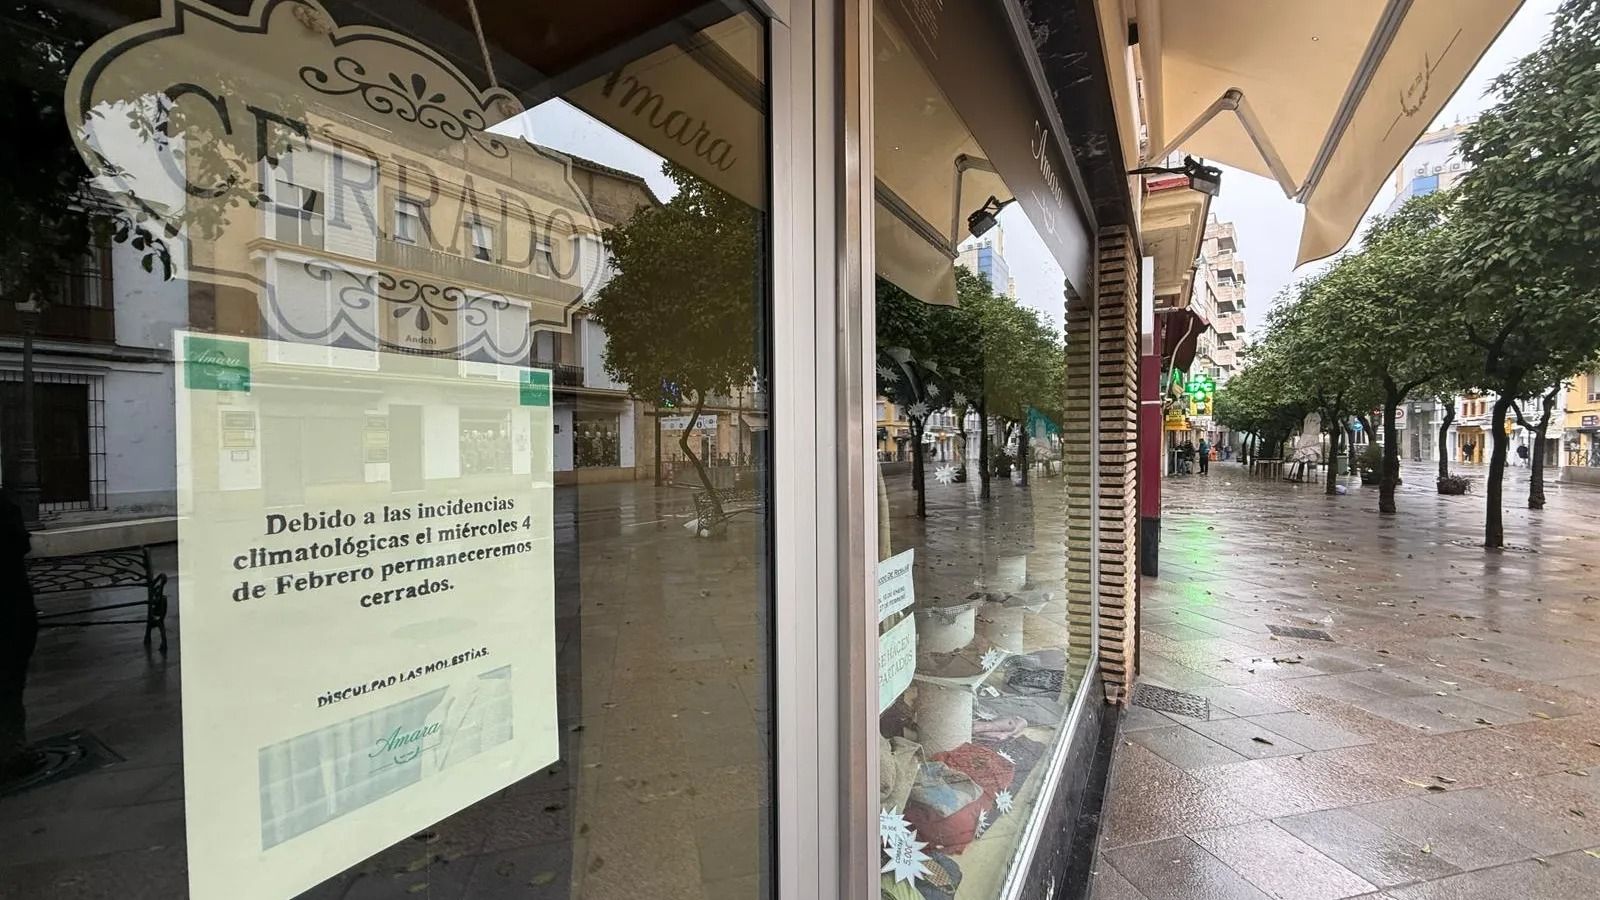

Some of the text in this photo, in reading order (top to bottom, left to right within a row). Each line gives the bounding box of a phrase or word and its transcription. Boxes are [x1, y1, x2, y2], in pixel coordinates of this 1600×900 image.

[156, 82, 581, 280] CERRADO
[264, 496, 514, 535] Debido a las incidencias
[233, 515, 531, 570] climatológicas el miércoles 4
[232, 541, 532, 602] de Febrero permaneceremos
[360, 579, 454, 608] cerrados.
[399, 666, 422, 683] LAS
[368, 722, 441, 758] Amara
